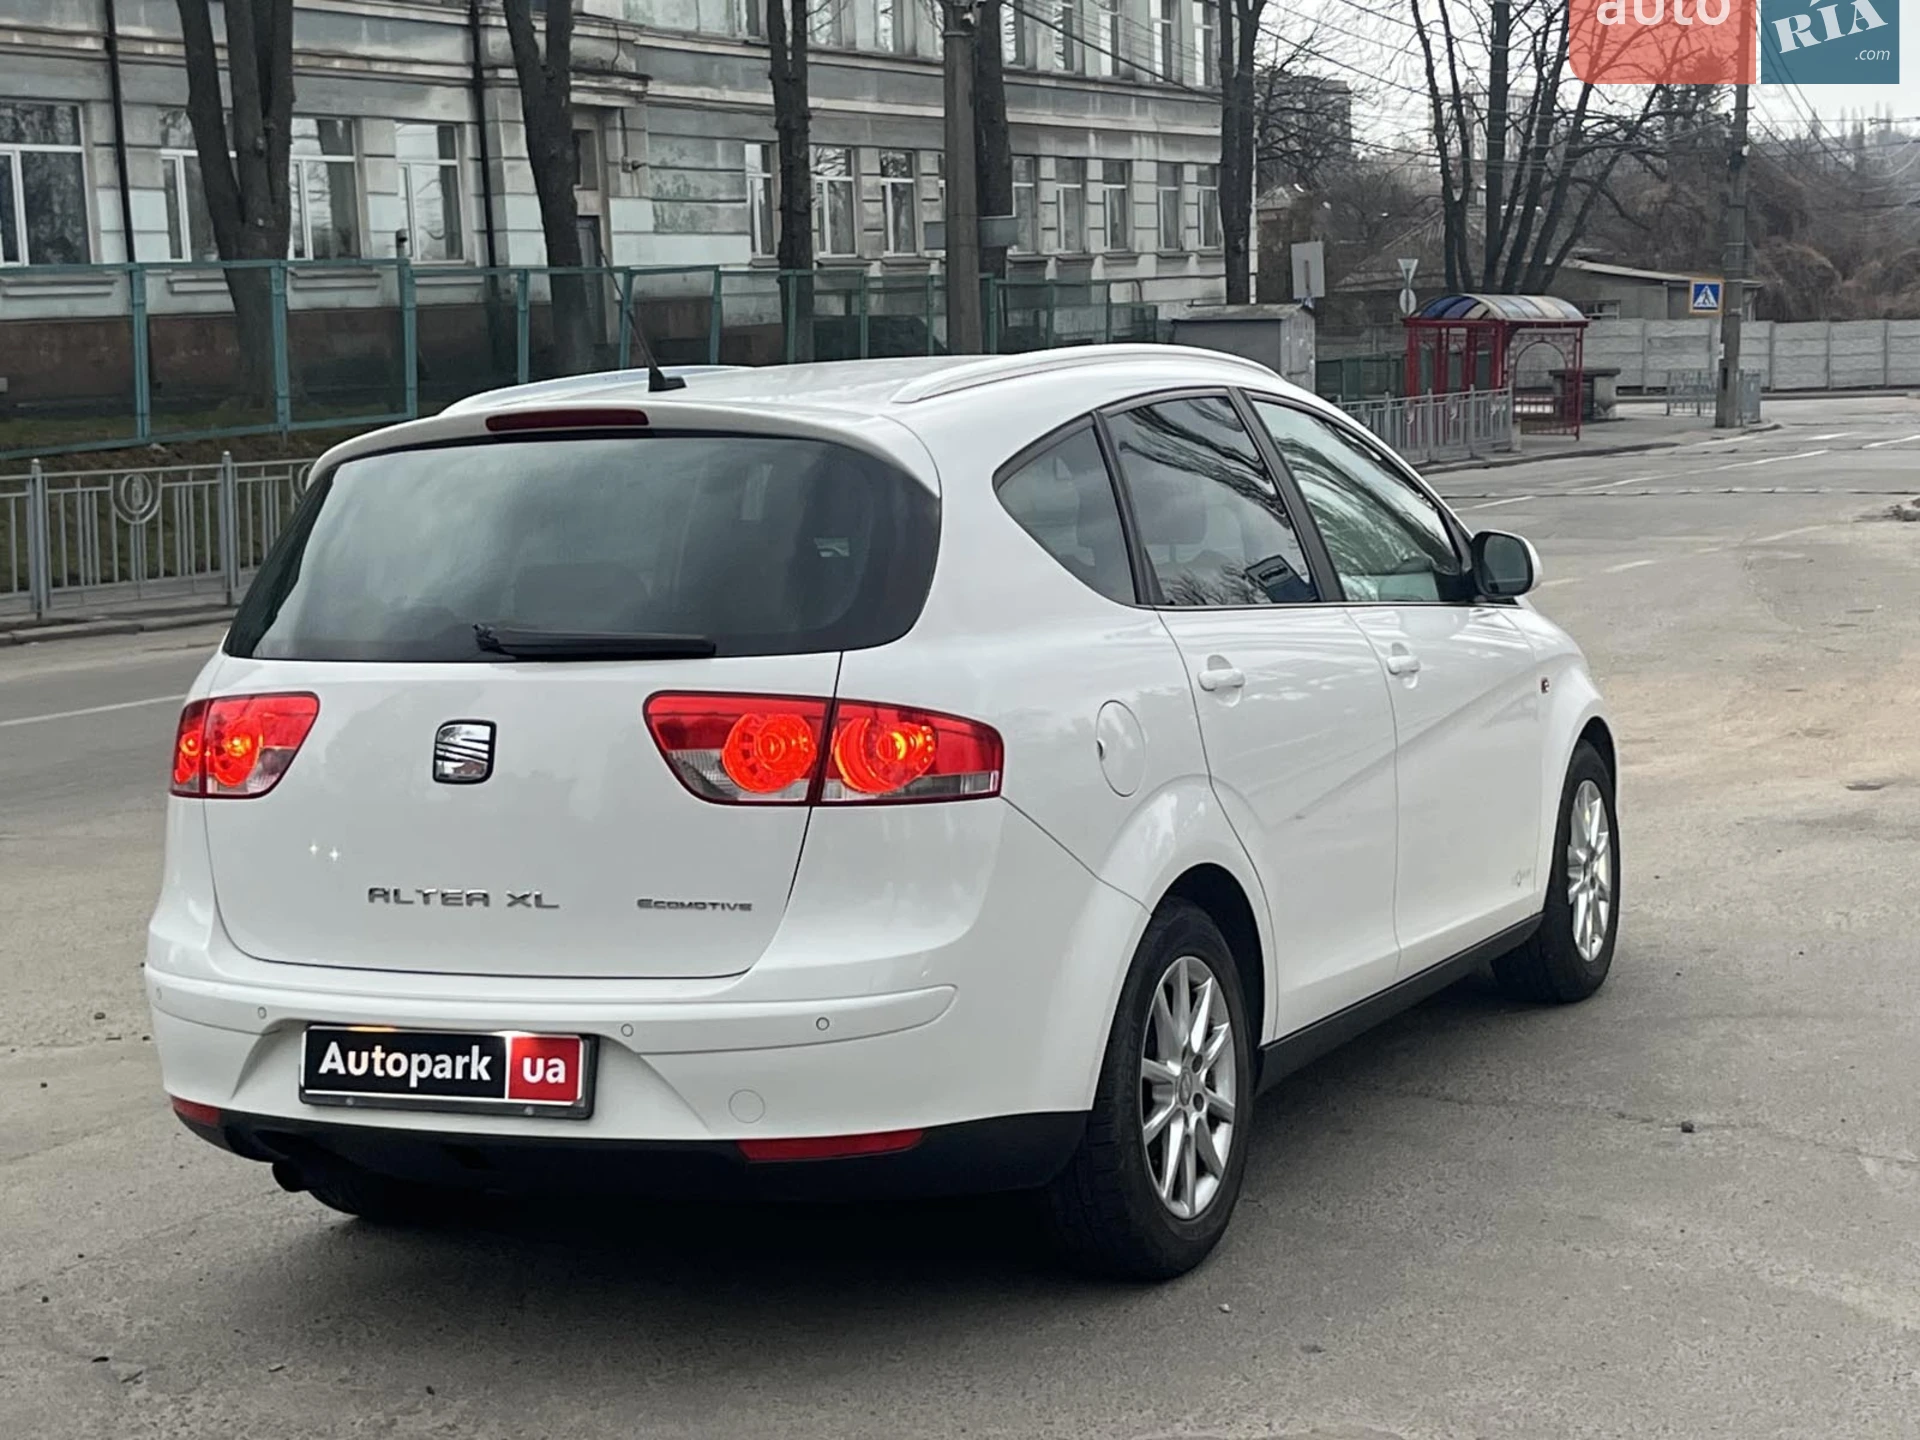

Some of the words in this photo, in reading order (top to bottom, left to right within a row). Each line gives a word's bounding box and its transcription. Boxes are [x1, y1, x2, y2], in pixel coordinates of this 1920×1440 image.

[368, 887, 490, 908] ALTEA
[506, 889, 560, 909] XL
[318, 1041, 492, 1088] Autopark
[522, 1056, 567, 1084] ua
